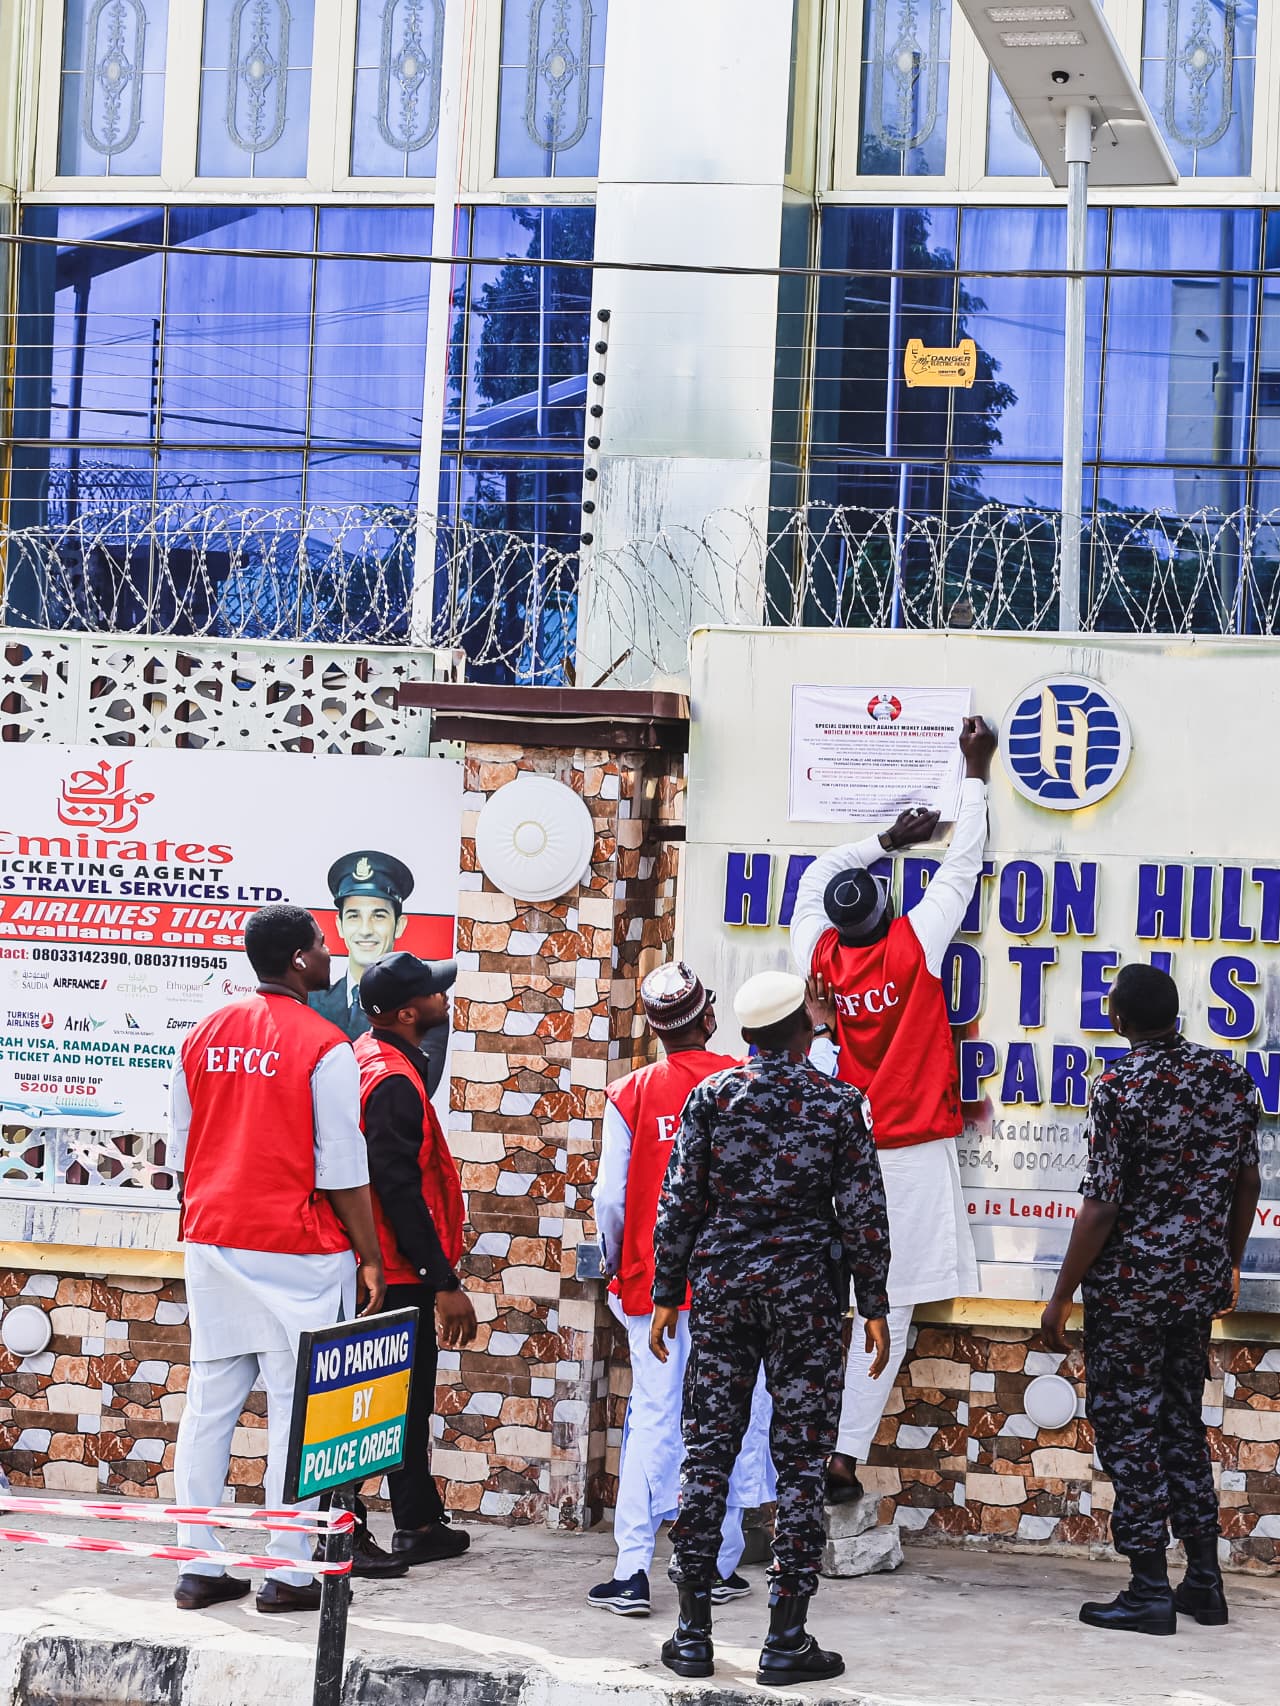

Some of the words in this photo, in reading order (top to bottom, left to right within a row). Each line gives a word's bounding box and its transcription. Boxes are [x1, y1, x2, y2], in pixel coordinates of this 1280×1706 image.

[0, 831, 234, 864] Emirates
[2, 860, 124, 878] ICKETING
[134, 866, 223, 881] AGENT
[22, 877, 112, 895] TRAVEL
[120, 881, 229, 899] SERVICES
[237, 886, 290, 902] LTD.
[11, 901, 161, 926] AIRLINES
[0, 922, 154, 941] Available
[162, 931, 205, 944] on
[33, 948, 132, 966] 08033142390,
[134, 953, 228, 969] 08037119545
[22, 981, 49, 990] SAUDIA
[53, 978, 100, 990] AIRFRANCE
[116, 984, 158, 994] ETIHAD
[166, 980, 204, 993] Ethiopian
[234, 986, 252, 996] Kenya
[941, 942, 1262, 1041] OTES
[834, 981, 899, 1016] EFCC
[7, 1011, 40, 1020] TURKISH
[7, 1020, 40, 1028] AIRLINES
[27, 1038, 58, 1050] VISA,
[63, 1040, 130, 1053] RAMADAN
[131, 1044, 176, 1056] PACKA
[7, 1051, 49, 1062] TICKET
[53, 1053, 81, 1064] AND
[85, 1055, 125, 1067] HOTEL
[128, 1058, 173, 1069] RESERV
[205, 1046, 280, 1077] EFCC
[14, 1072, 40, 1081] Dubai
[43, 1074, 63, 1083] Visa
[65, 1076, 86, 1085] only
[88, 1077, 103, 1085] for
[64, 1085, 97, 1096] USD
[656, 1114, 677, 1142] E
[991, 1119, 1069, 1143] Kaduna
[985, 1199, 1002, 1215] is
[1009, 1198, 1077, 1220] Leadin
[315, 1347, 341, 1383] NO
[343, 1331, 409, 1377] PARKING
[351, 1387, 374, 1423] BY
[303, 1439, 358, 1485] POLICE
[358, 1424, 402, 1467] ORDER
